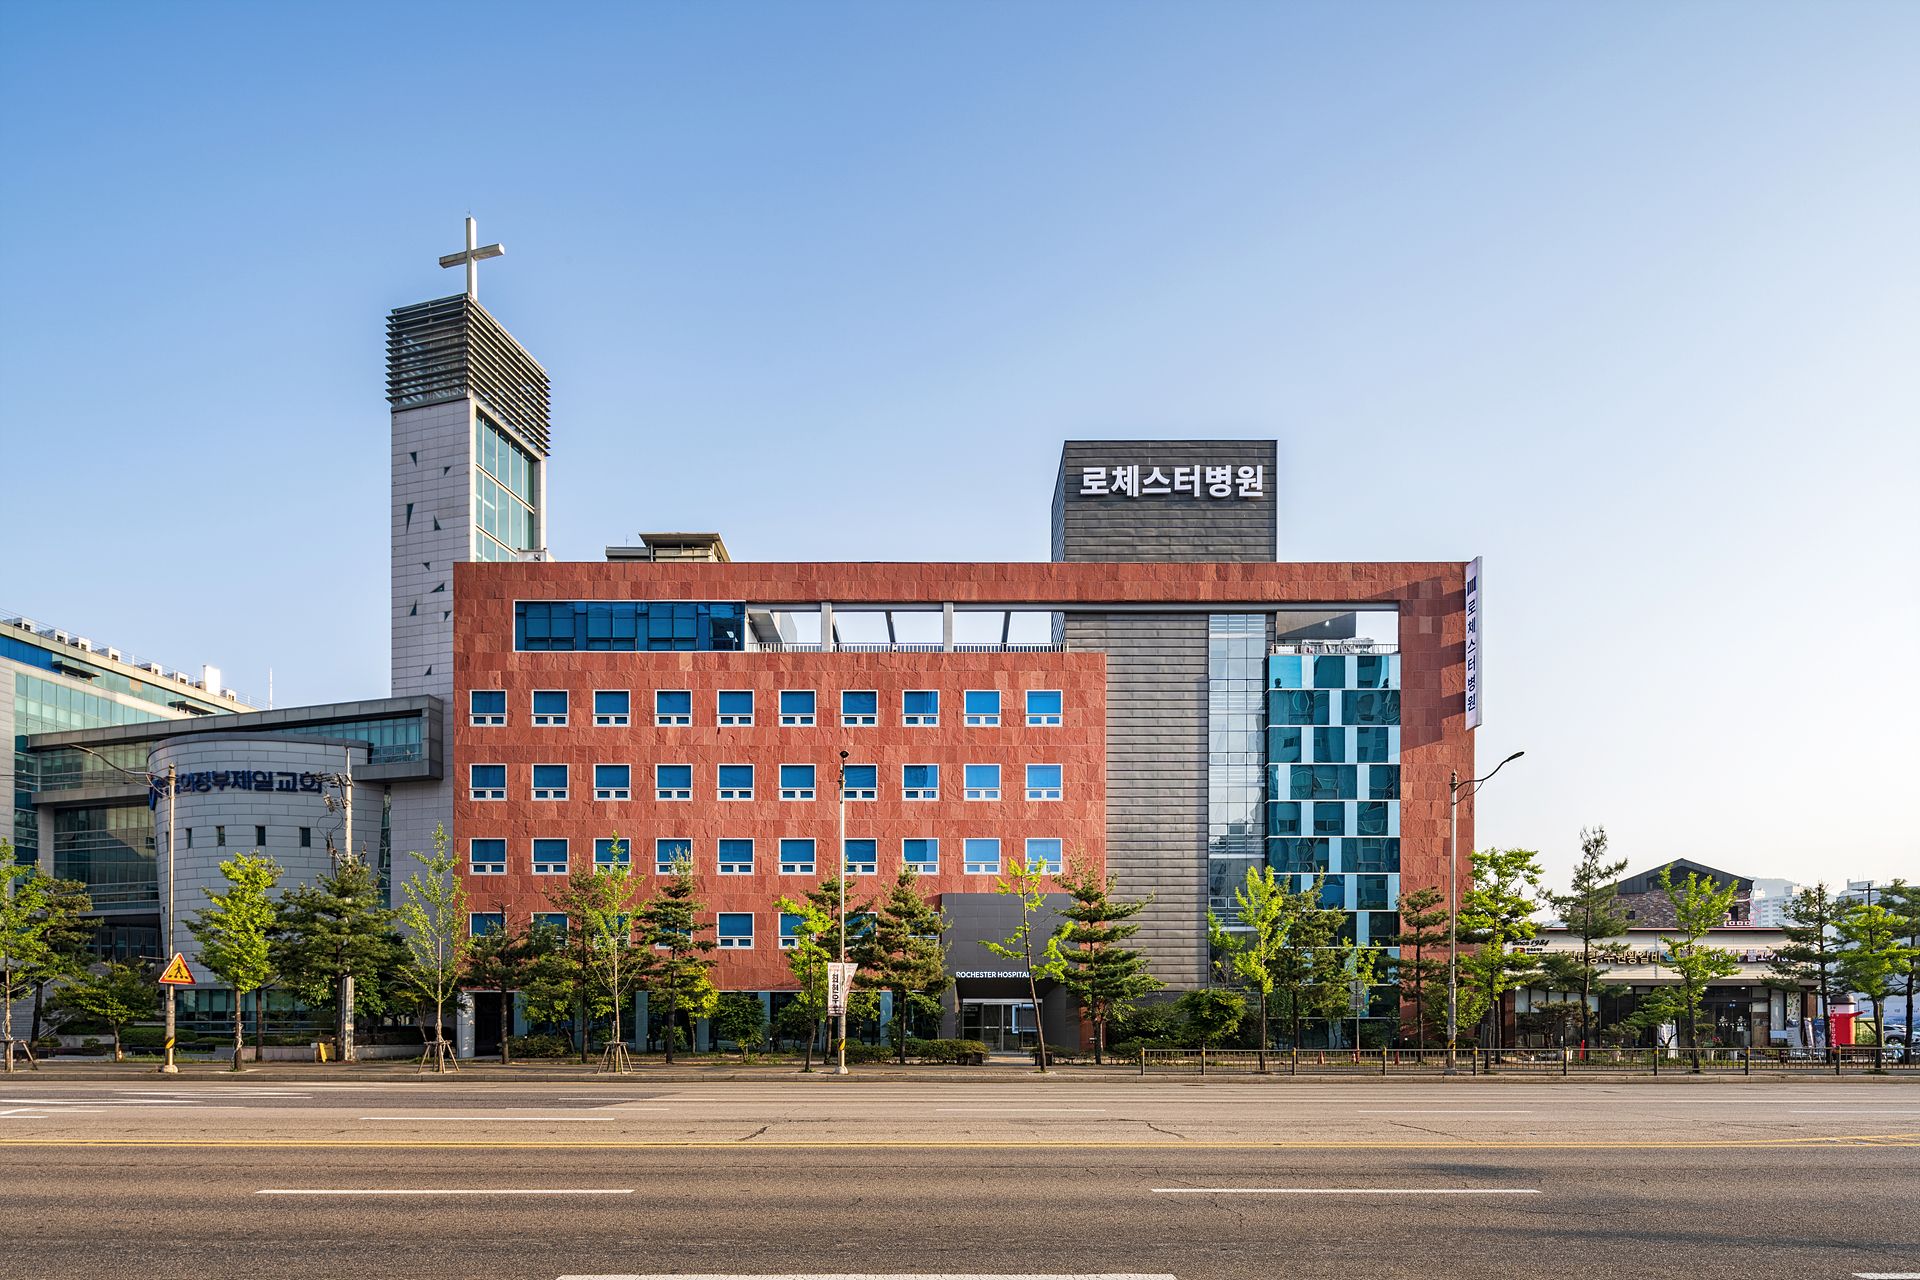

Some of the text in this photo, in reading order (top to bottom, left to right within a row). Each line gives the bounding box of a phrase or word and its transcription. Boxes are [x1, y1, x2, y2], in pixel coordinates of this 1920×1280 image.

[1080, 465, 1263, 497] 로체스터병원
[1467, 599, 1476, 711] 로체스터병원
[1530, 939, 1550, 947] 1984
